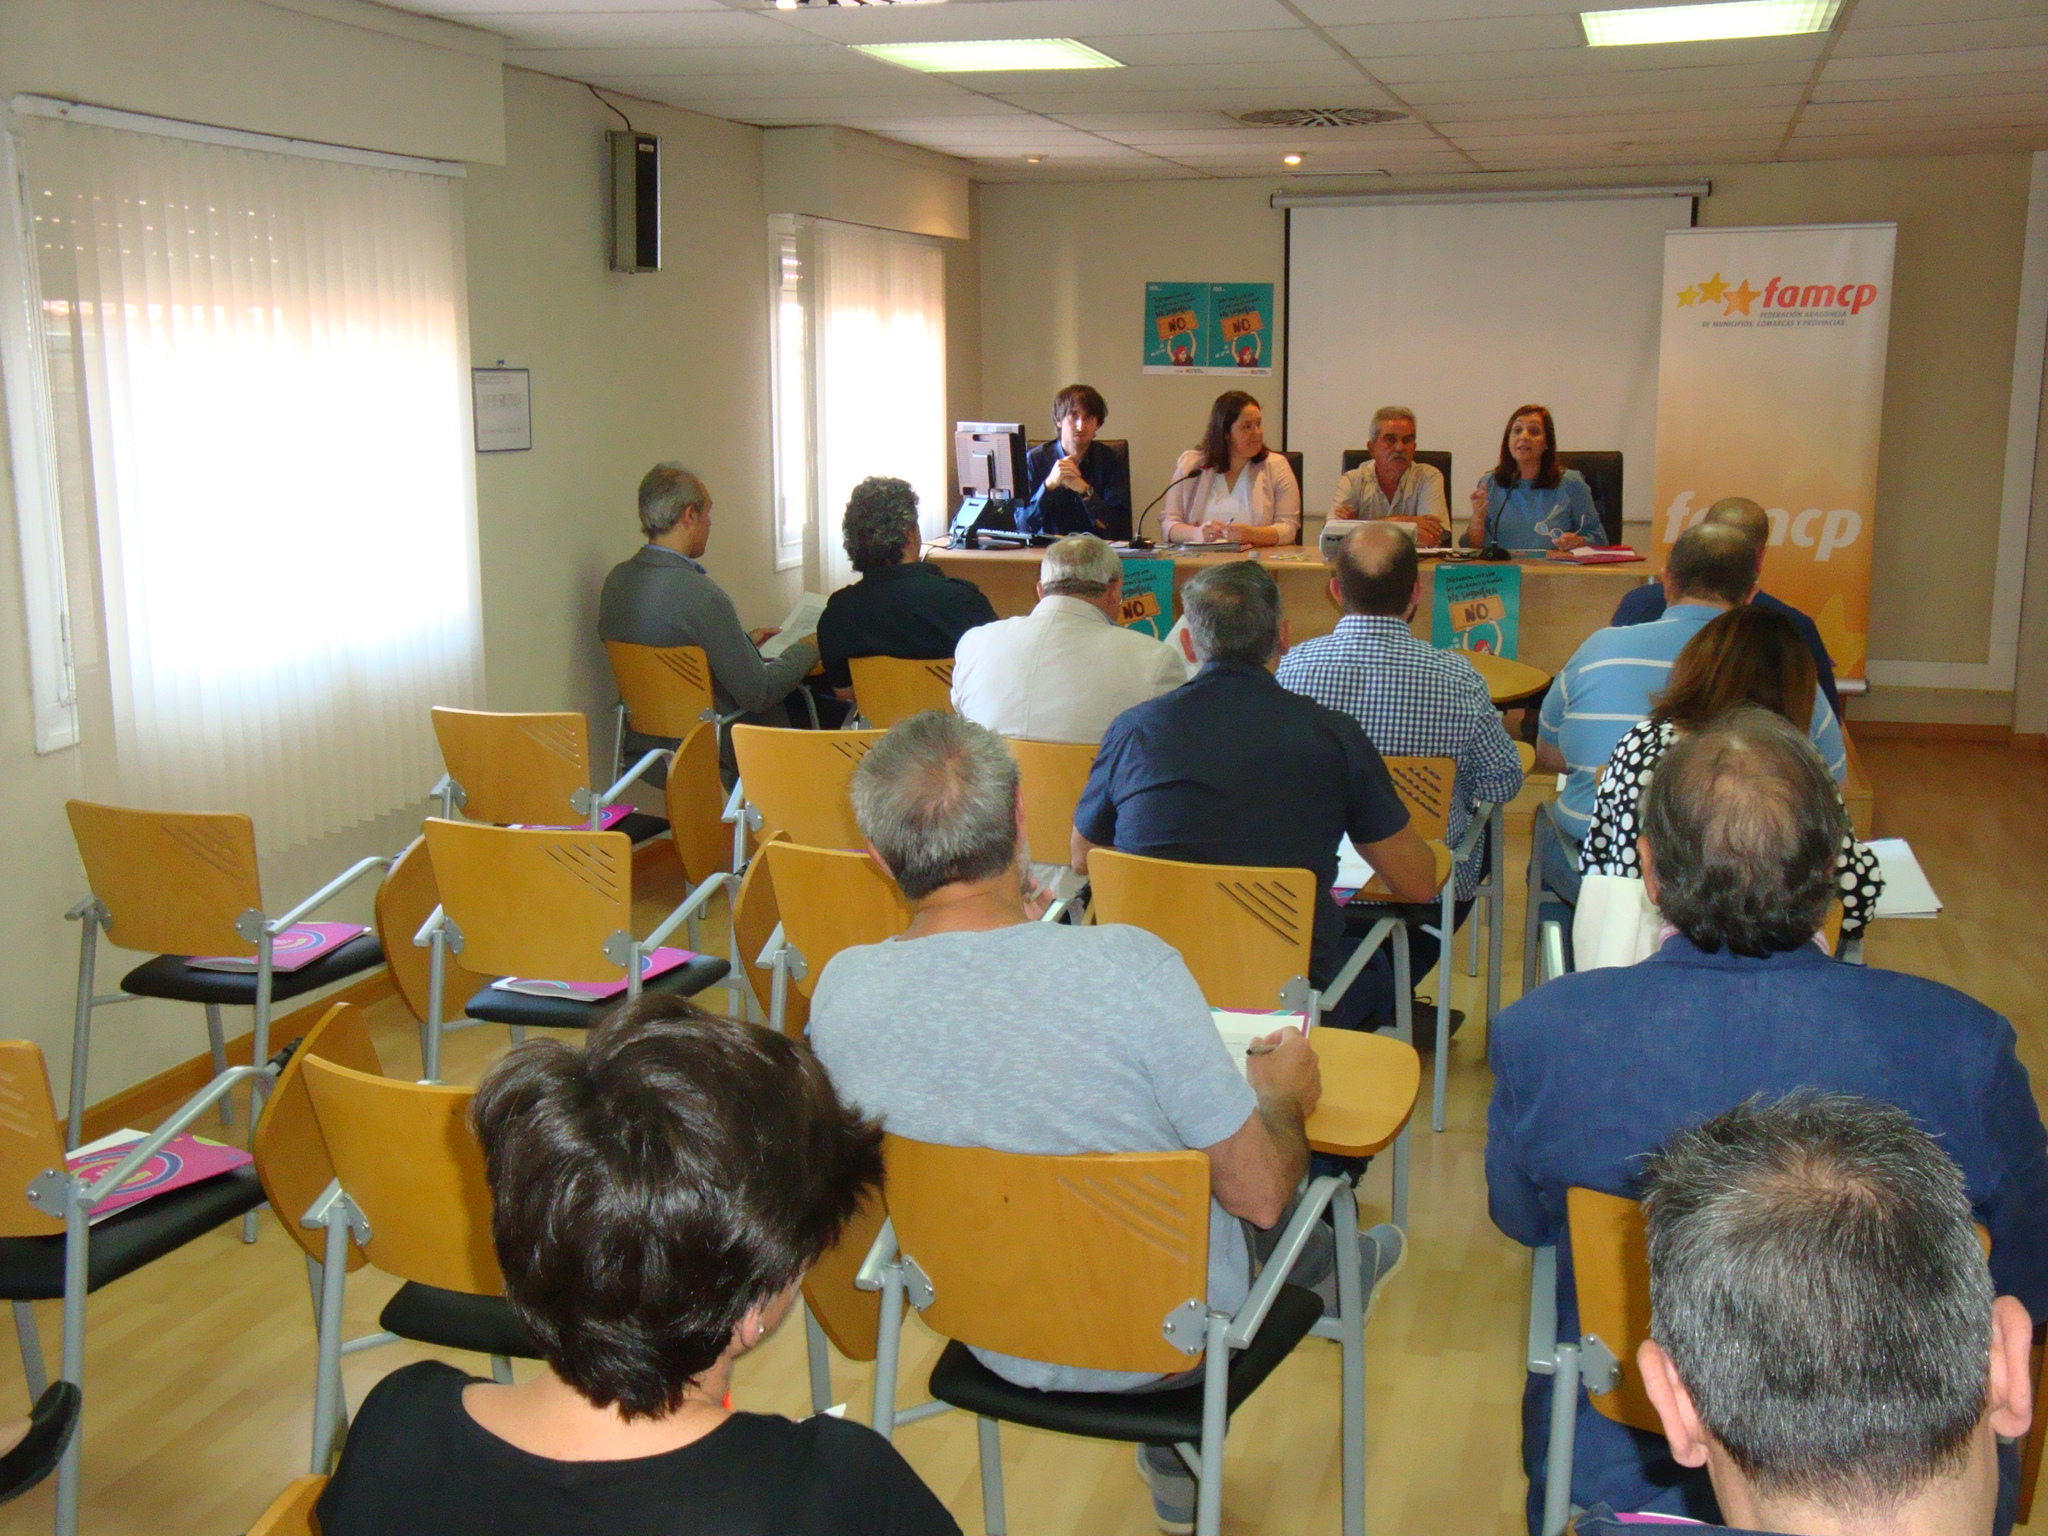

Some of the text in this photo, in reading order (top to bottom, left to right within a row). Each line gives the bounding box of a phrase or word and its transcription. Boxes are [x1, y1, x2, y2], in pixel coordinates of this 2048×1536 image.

[1763, 276, 1878, 315] famcp
[1168, 317, 1187, 333] NO
[1232, 318, 1251, 333] NO
[1663, 490, 1863, 562] fcp
[1122, 600, 1145, 619] NO
[1465, 603, 1489, 622] NO
